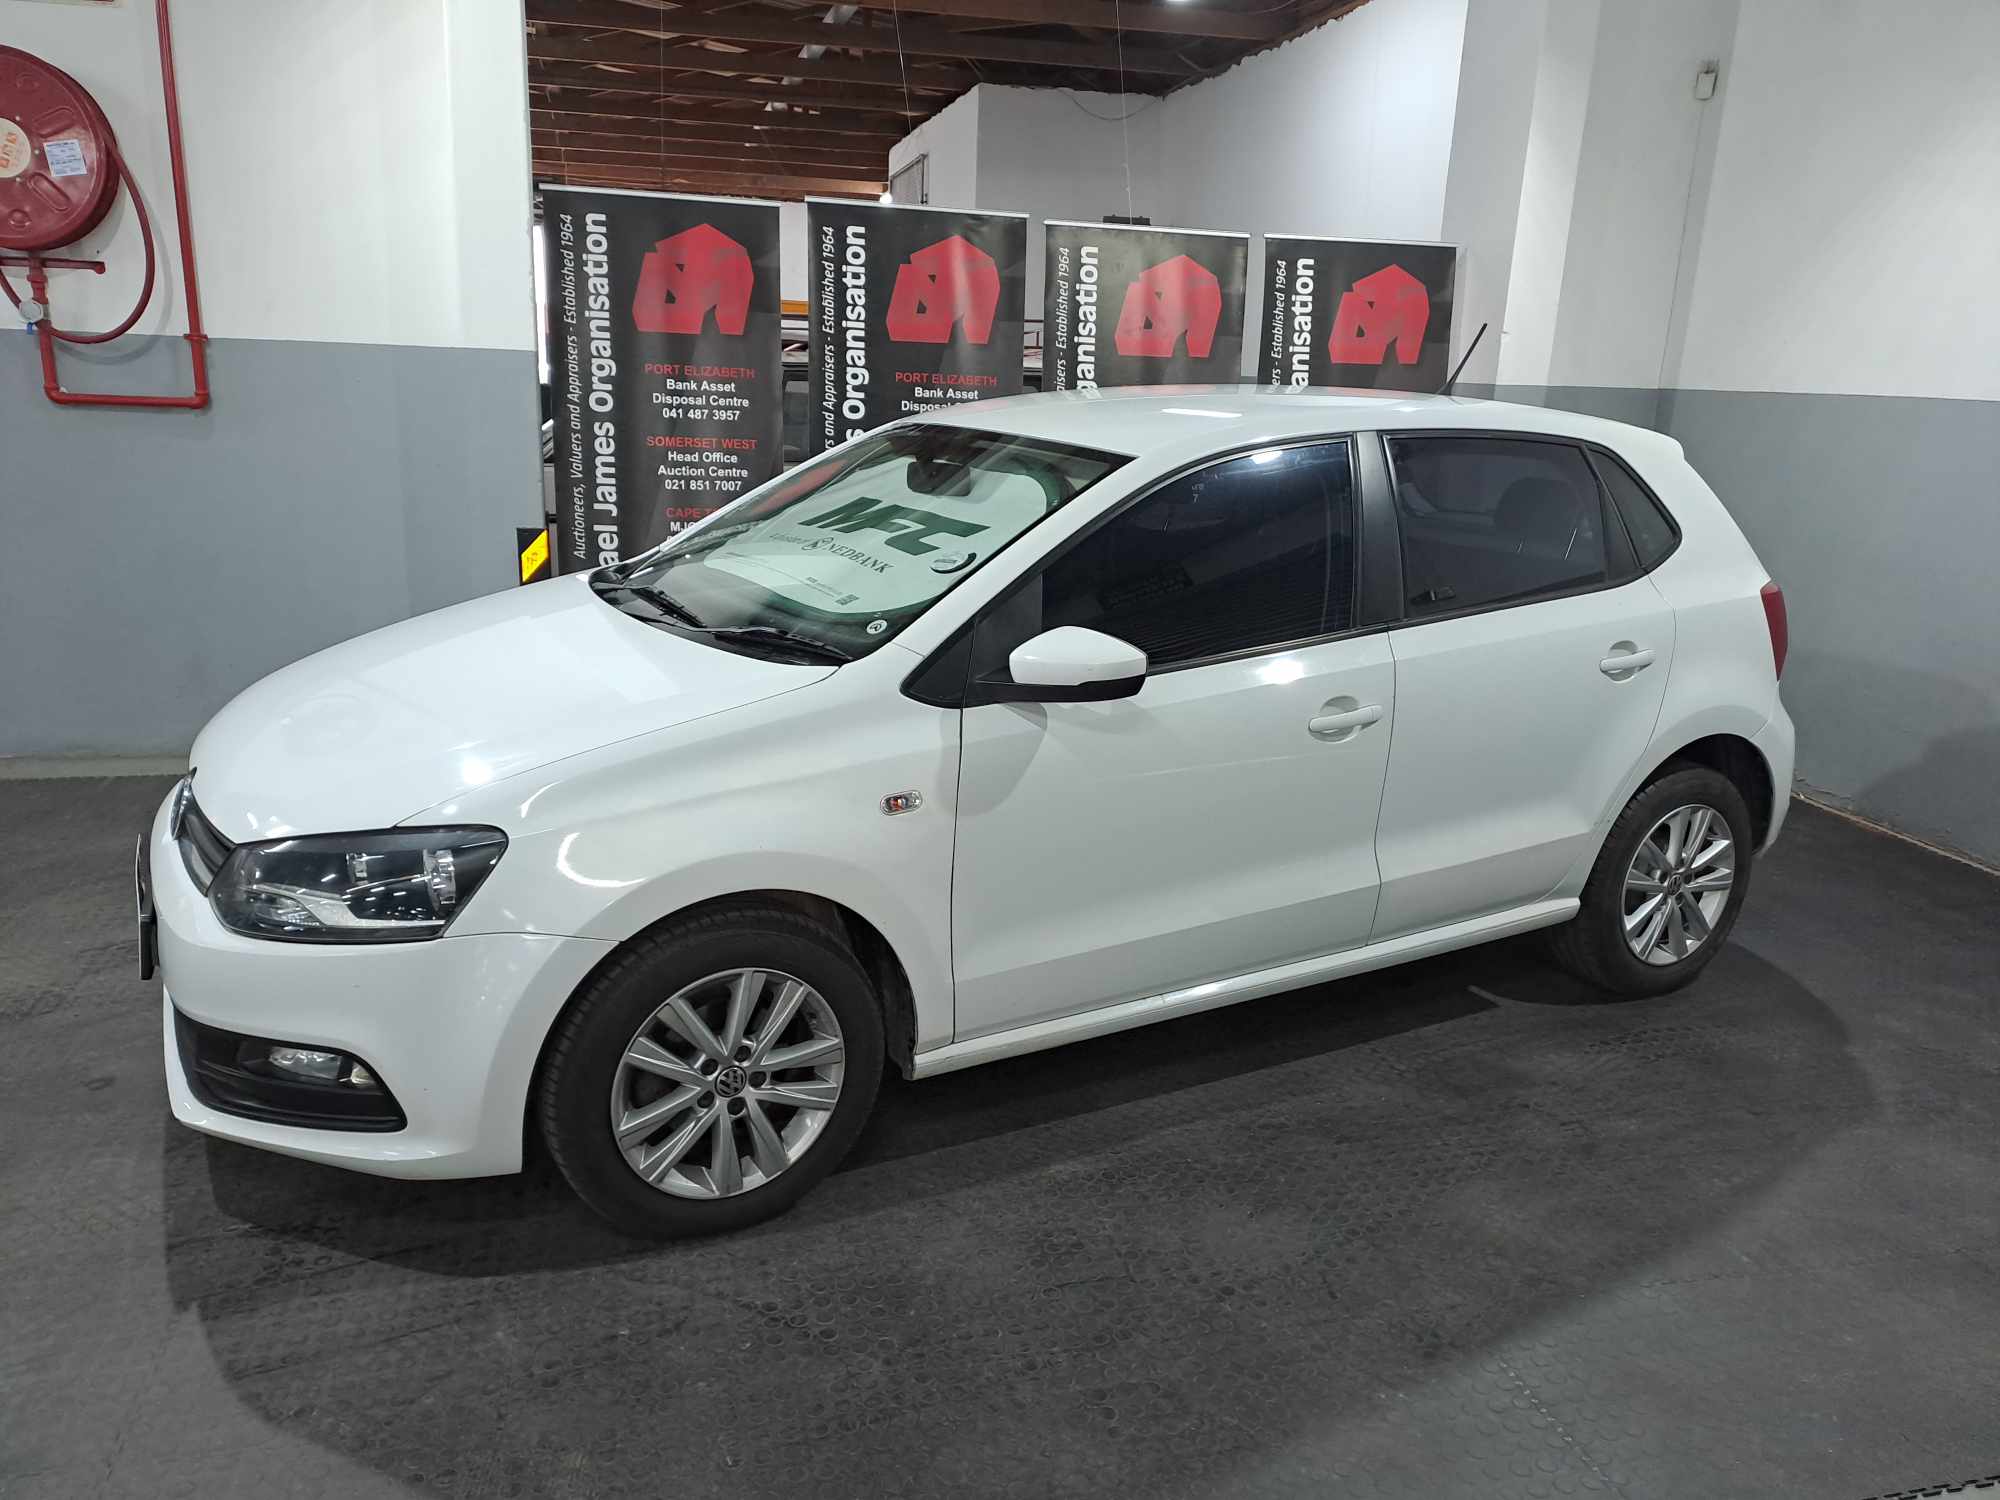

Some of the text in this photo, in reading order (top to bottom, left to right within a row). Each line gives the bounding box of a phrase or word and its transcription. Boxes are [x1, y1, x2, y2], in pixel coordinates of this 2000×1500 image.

[559, 213, 574, 247] 1964
[822, 225, 835, 258] 1964
[1058, 247, 1070, 277] 1964
[1275, 259, 1287, 289] 1964
[559, 249, 577, 325] Established
[821, 260, 835, 334] Established
[583, 212, 616, 413] Organisation
[841, 225, 870, 420] Organisation
[1055, 279, 1070, 349] Established
[1271, 291, 1285, 359] Established
[564, 335, 583, 403] Appraisers
[644, 363, 756, 378] PORT ELIZABETH
[822, 343, 838, 411] Appraisers
[895, 371, 998, 386] PORT ELIZABETH
[652, 392, 750, 407] Disposal Centre
[665, 378, 736, 393] Bank Asset
[914, 386, 979, 400] Bank Asset
[567, 403, 582, 430] and
[662, 407, 740, 421] 041 487 3957
[821, 410, 835, 437] and
[569, 432, 583, 479] Valuers
[645, 435, 758, 450] SOMERSET WEST
[667, 450, 738, 464] Head Office
[593, 421, 618, 517] James
[657, 464, 749, 478] Auction Centre
[664, 479, 742, 491] 021 851 7007
[573, 483, 587, 560] Auctioneers,
[665, 506, 702, 519] CAPE
[826, 543, 895, 574] NEDBANK
